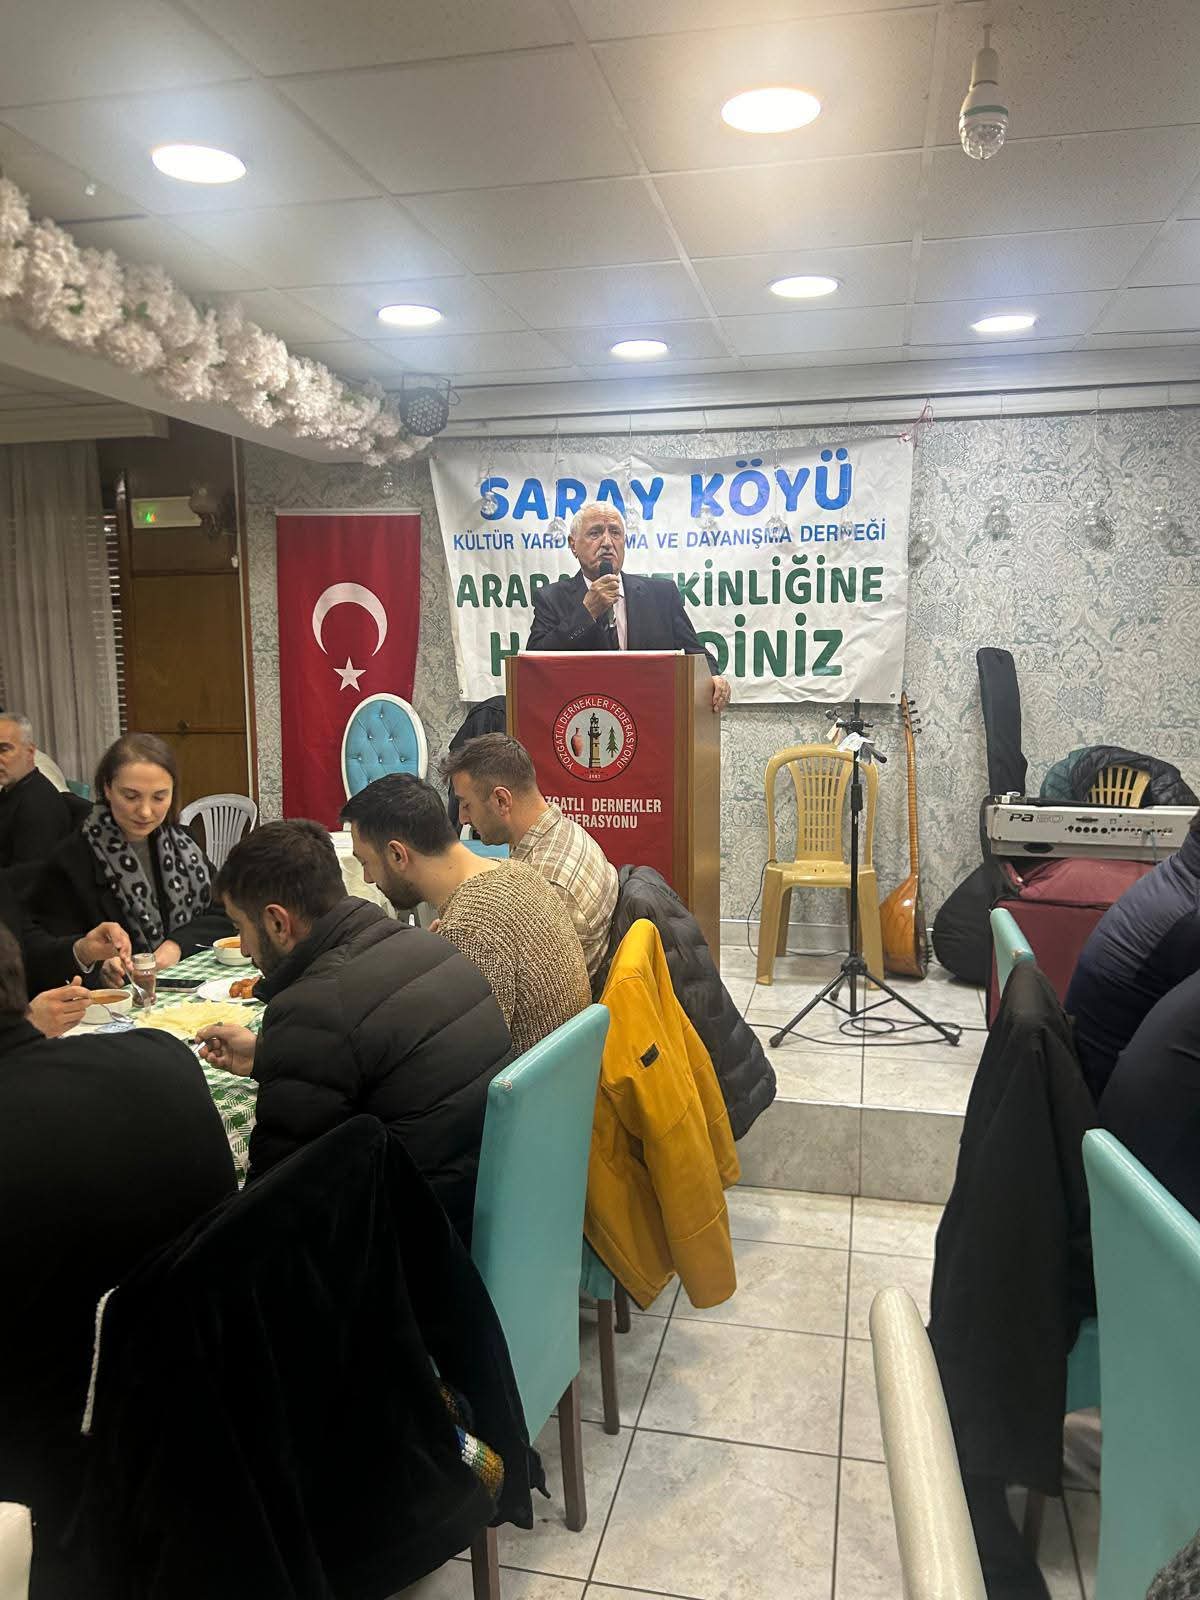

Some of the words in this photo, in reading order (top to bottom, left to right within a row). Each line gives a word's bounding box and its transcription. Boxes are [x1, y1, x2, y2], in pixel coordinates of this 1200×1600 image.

[480, 476, 665, 521] SARAY
[690, 447, 852, 519] KÖYÜ
[453, 529, 514, 550] KÜLTÜR
[521, 532, 649, 549] YARDMA
[656, 532, 679, 549] VE
[686, 526, 792, 549] DAYANIŞMA
[800, 518, 887, 542] DERNEĞİ
[640, 554, 884, 607] KİNLİĞİNE
[559, 698, 609, 725] DERNEKLER
[555, 724, 574, 770] YOZGATLI
[609, 703, 635, 769] FEDERASYONU
[591, 797, 662, 813] DERNEKLER
